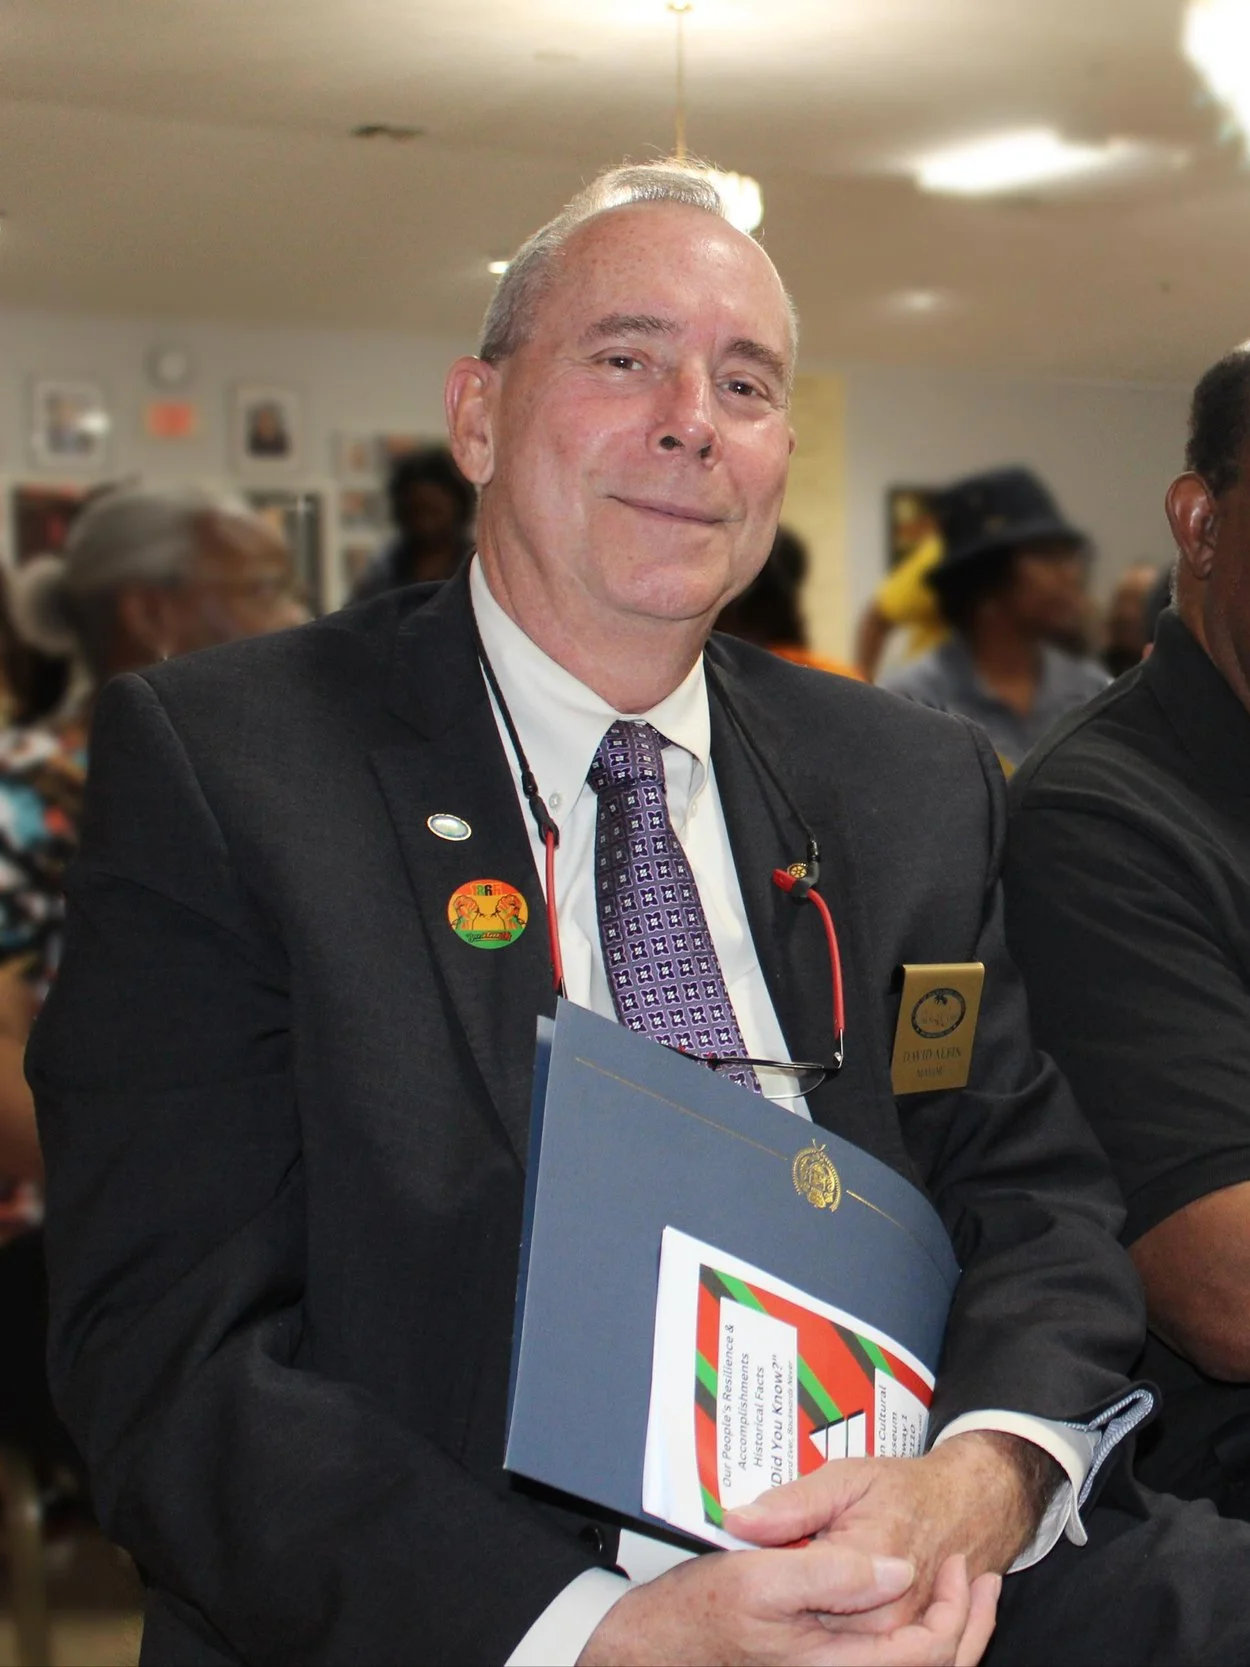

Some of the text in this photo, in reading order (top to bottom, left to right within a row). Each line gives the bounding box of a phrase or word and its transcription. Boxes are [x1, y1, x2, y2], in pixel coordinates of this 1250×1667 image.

[722, 1324, 735, 1488] Our People's Resilience &
[737, 1353, 749, 1472] Accomplishments
[752, 1366, 765, 1468] Historical Facts
[772, 1354, 784, 1416] Know?"
[772, 1420, 784, 1453] You
